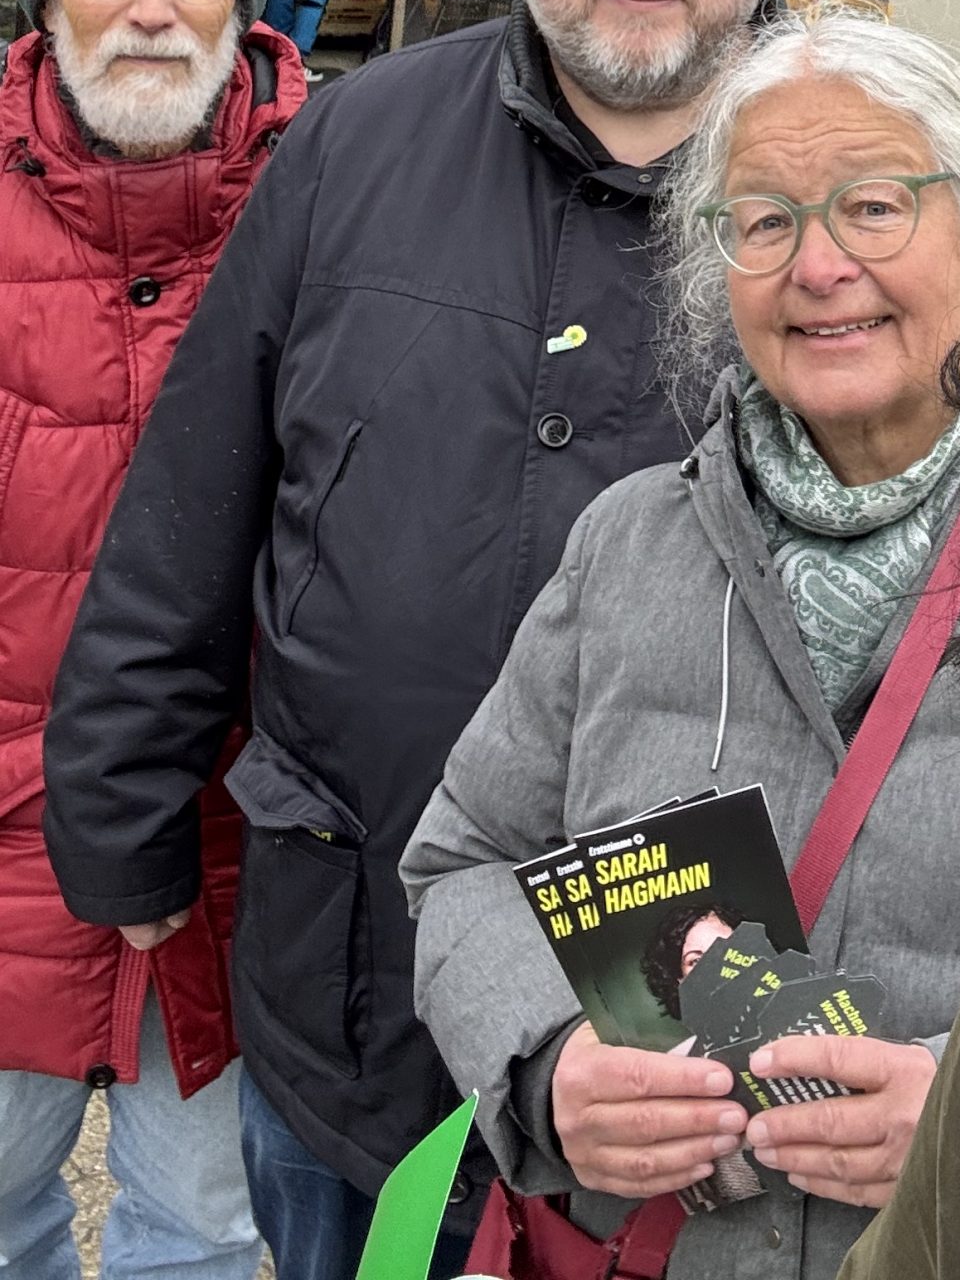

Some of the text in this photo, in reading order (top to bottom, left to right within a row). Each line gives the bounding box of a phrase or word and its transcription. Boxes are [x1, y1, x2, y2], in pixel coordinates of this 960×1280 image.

[595, 843, 668, 885] SARAH
[604, 862, 711, 914] HAGMANN
[819, 999, 842, 1024] was
